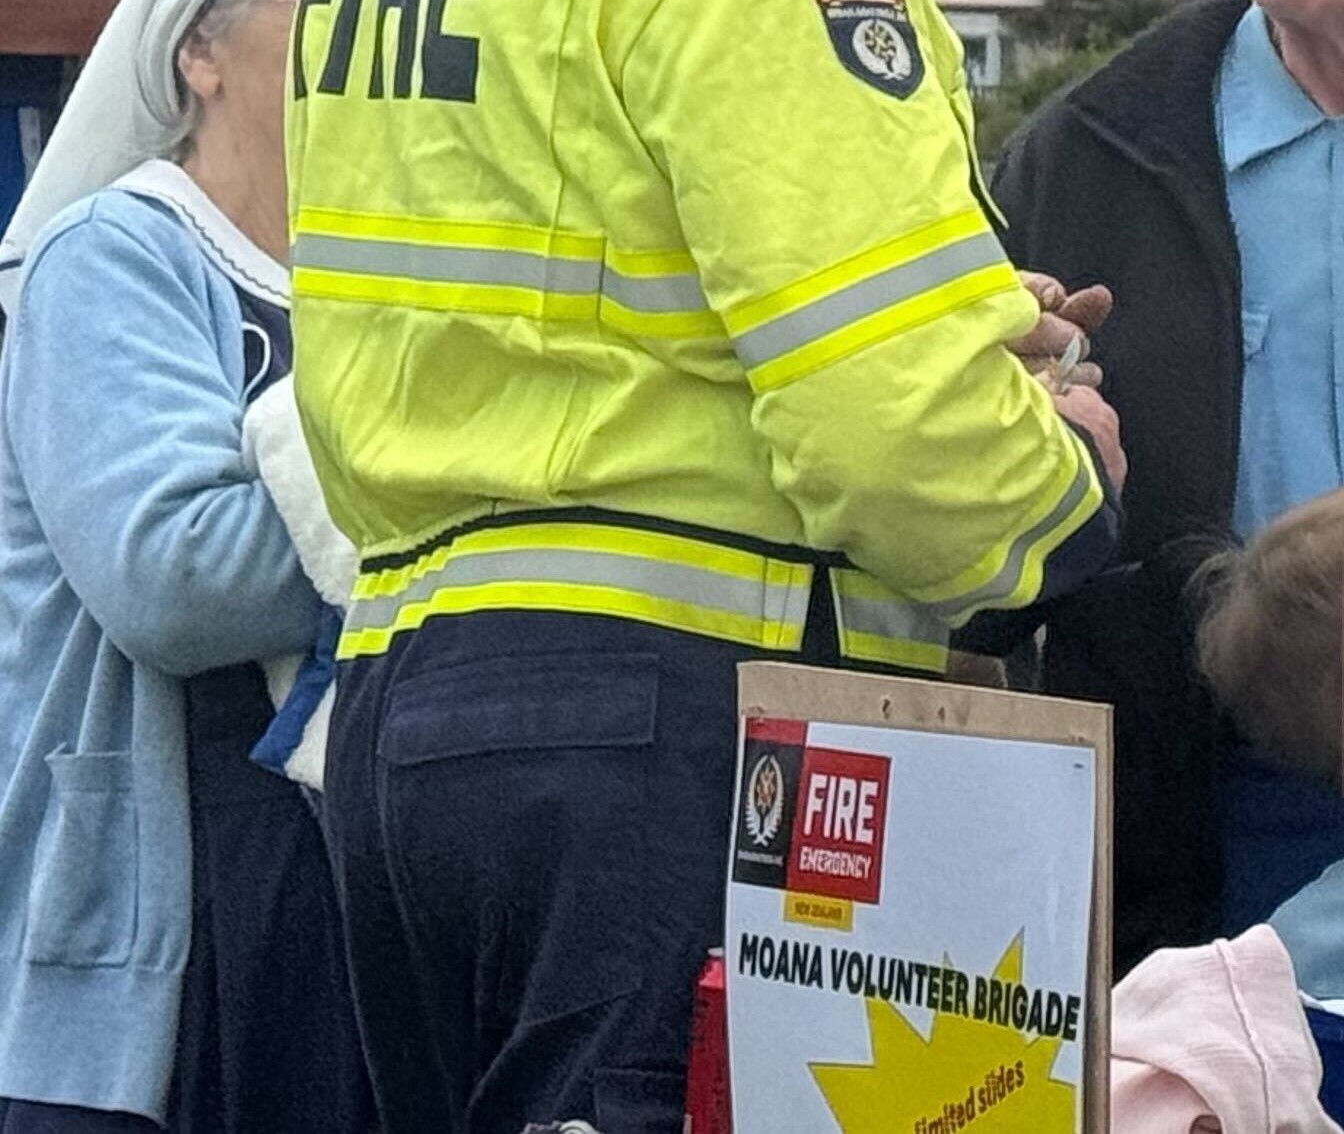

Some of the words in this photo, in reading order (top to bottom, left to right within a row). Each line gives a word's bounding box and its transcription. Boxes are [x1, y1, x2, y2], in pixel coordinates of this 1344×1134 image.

[803, 773, 880, 845] FIRE
[799, 846, 872, 880] EMERGENCY
[738, 932, 824, 990] MOANA
[830, 948, 970, 1019] VOLUNTEER
[973, 974, 1082, 1042] BRIGADE
[977, 1059, 1025, 1114] slides
